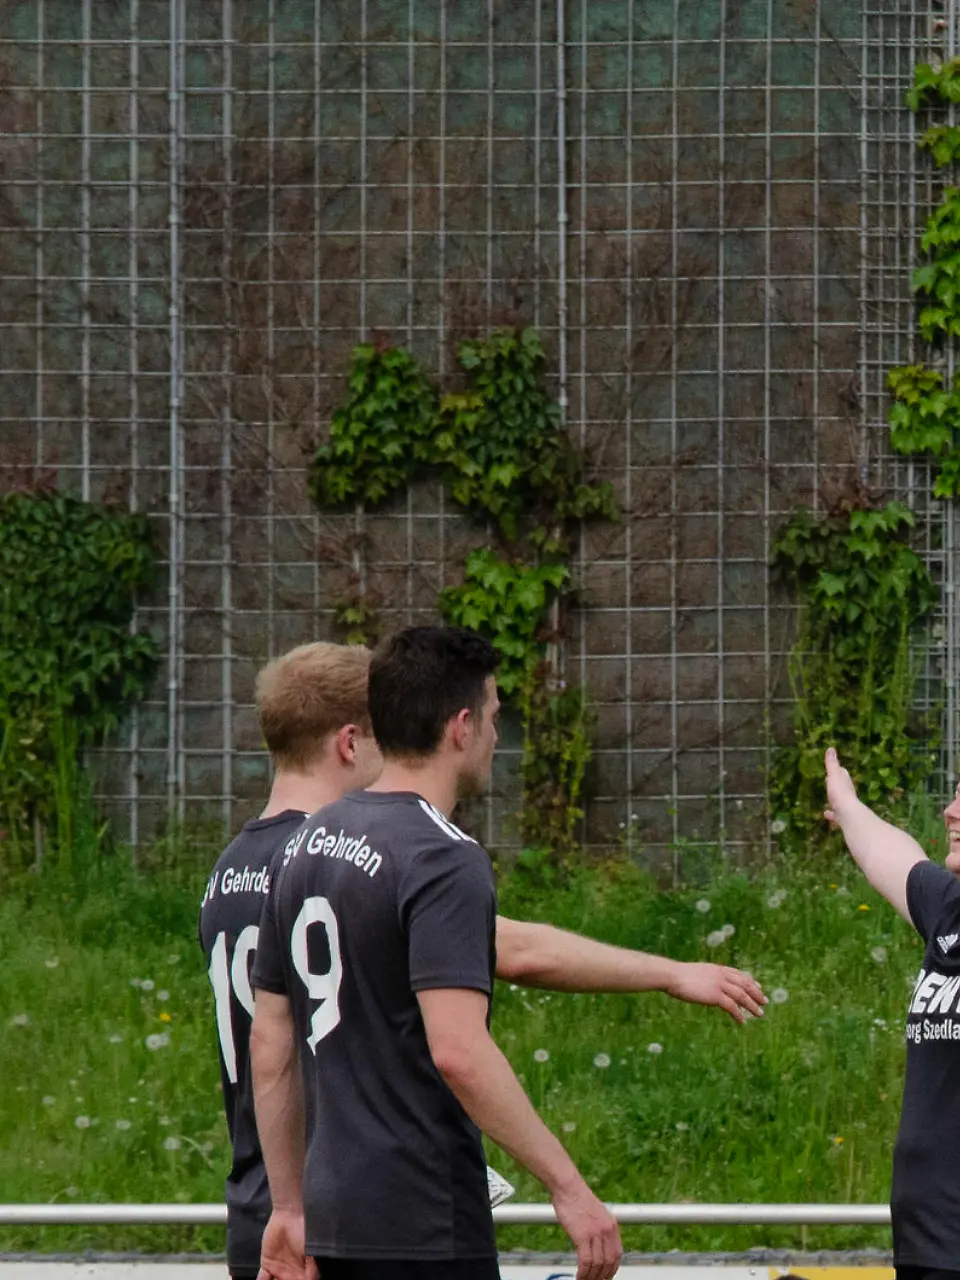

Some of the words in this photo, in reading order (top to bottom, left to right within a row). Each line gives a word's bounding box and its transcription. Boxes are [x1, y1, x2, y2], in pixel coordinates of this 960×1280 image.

[284, 828, 309, 867] SV
[307, 826, 383, 878] Gehrden
[291, 896, 343, 1056] 9
